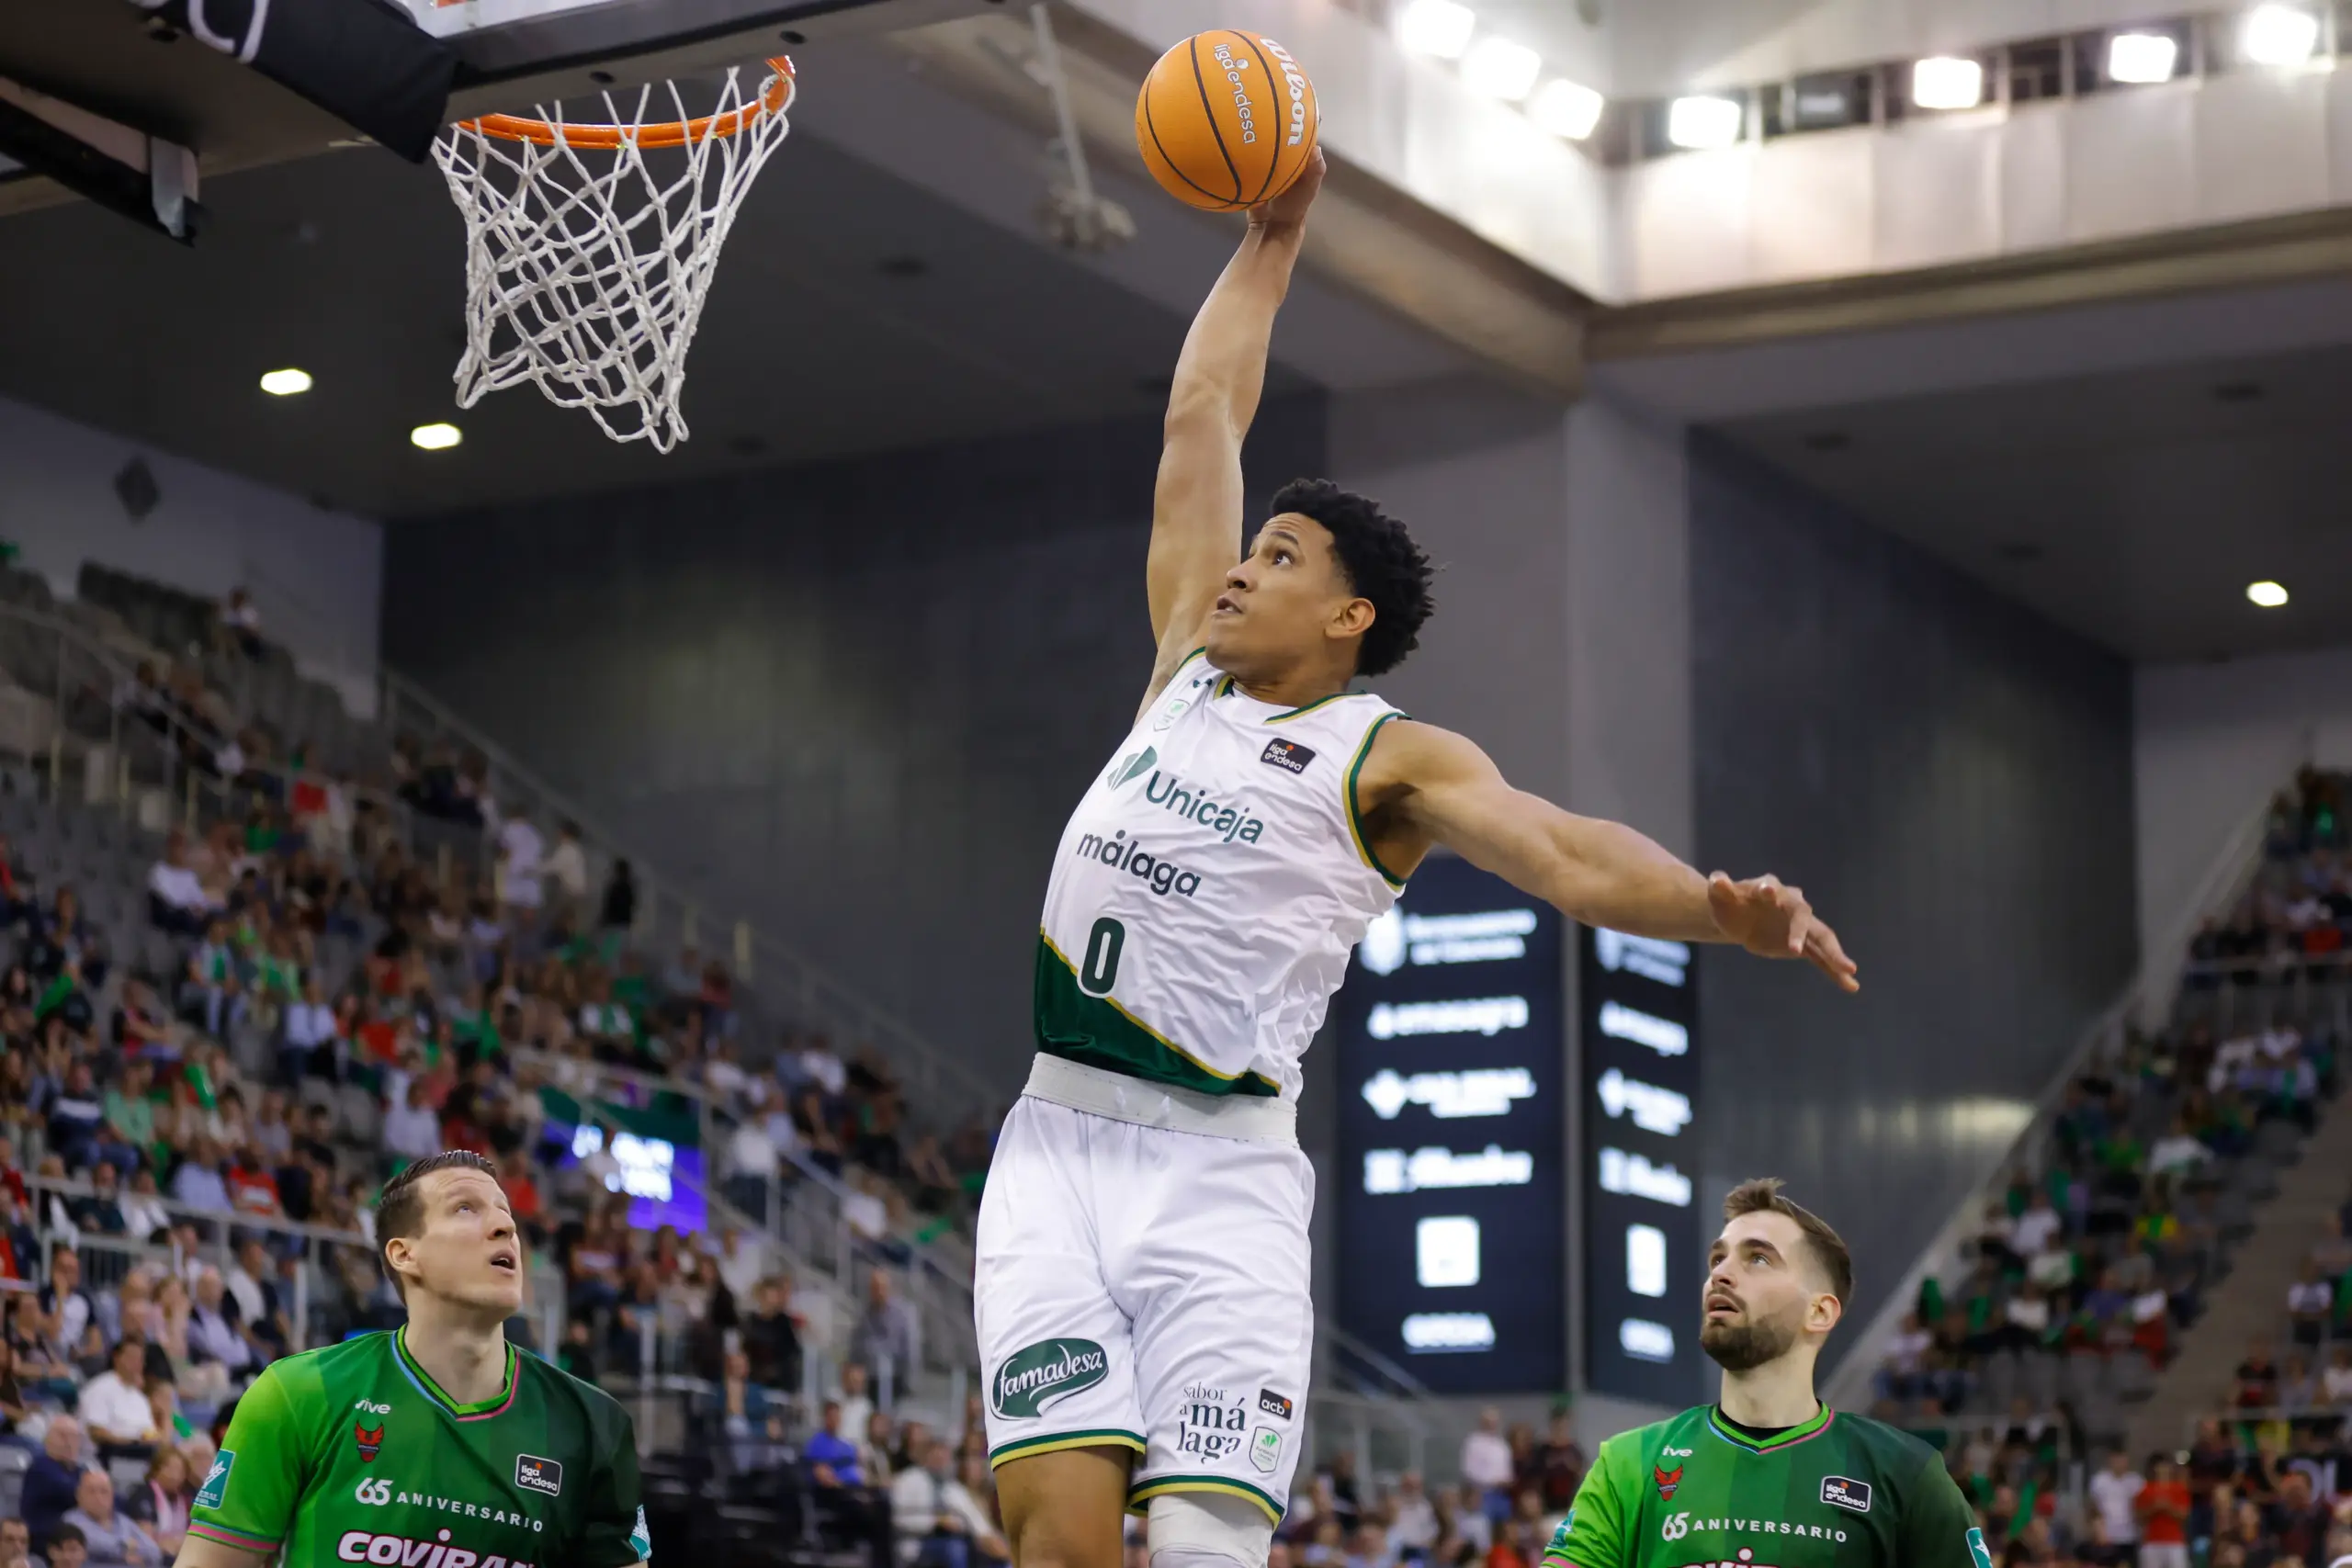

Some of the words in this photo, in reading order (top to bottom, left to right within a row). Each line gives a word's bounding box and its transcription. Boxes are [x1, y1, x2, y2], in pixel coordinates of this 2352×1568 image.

[1214, 44, 1236, 70] liga
[1227, 72, 1256, 143] endesa
[1269, 744, 1288, 755] liga
[1265, 752, 1303, 772] endesa
[1146, 771, 1264, 844] Unicaja
[1077, 829, 1202, 897] málaga
[1080, 917, 1125, 994] 0
[997, 1344, 1102, 1412] famadesa
[1183, 1382, 1227, 1401] sabor
[1261, 1399, 1285, 1415] acb
[521, 1465, 540, 1476] liga
[520, 1476, 558, 1491] endesa
[1826, 1483, 1846, 1494] liga
[356, 1477, 393, 1506] 65
[397, 1492, 544, 1532] ANIVERSARIO
[1825, 1493, 1866, 1507] endesa
[1662, 1512, 1690, 1541] 65
[1693, 1518, 1847, 1542] ANIVERSARIO
